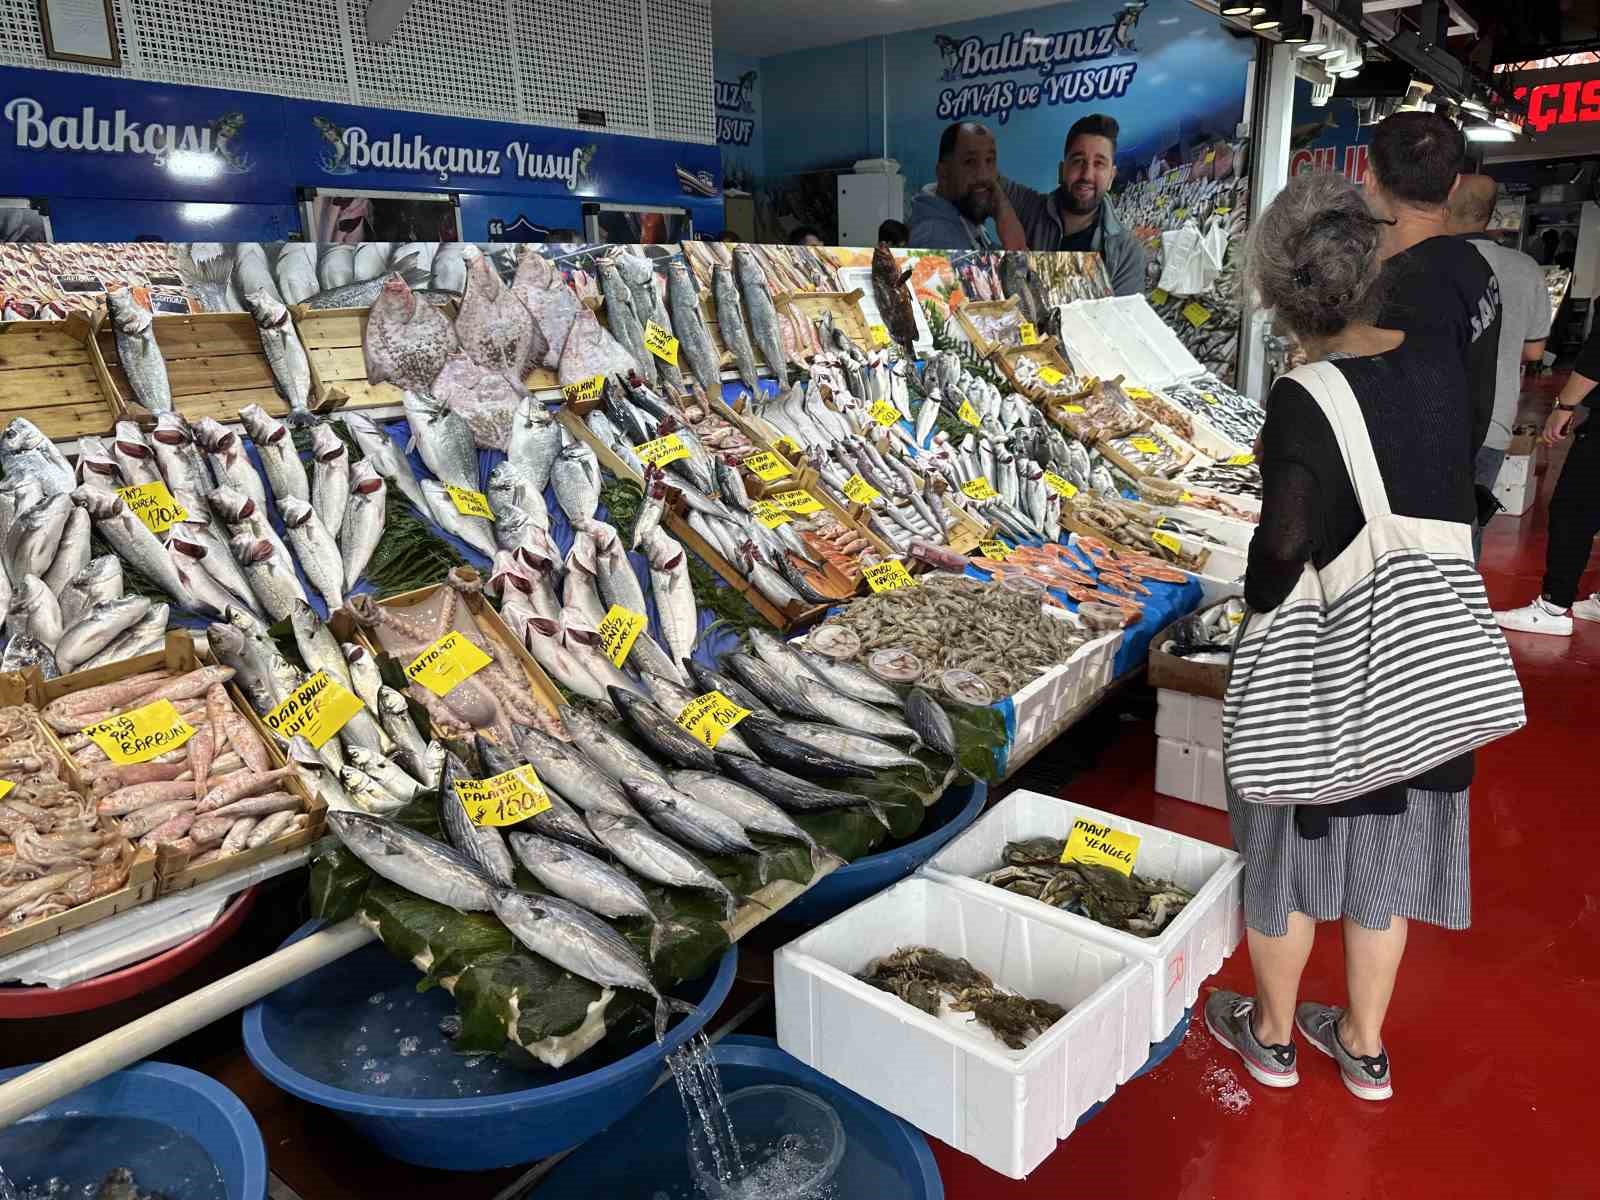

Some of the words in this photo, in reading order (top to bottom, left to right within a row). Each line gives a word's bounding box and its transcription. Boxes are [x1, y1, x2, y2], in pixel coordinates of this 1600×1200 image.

[959, 26, 1114, 74] Balıkçınız
[939, 82, 1014, 121] SAVAŞ
[1018, 85, 1040, 106] ve
[1045, 64, 1135, 101] YUSUF
[342, 126, 501, 181] Balıkçınız
[506, 141, 583, 191] Yusuf
